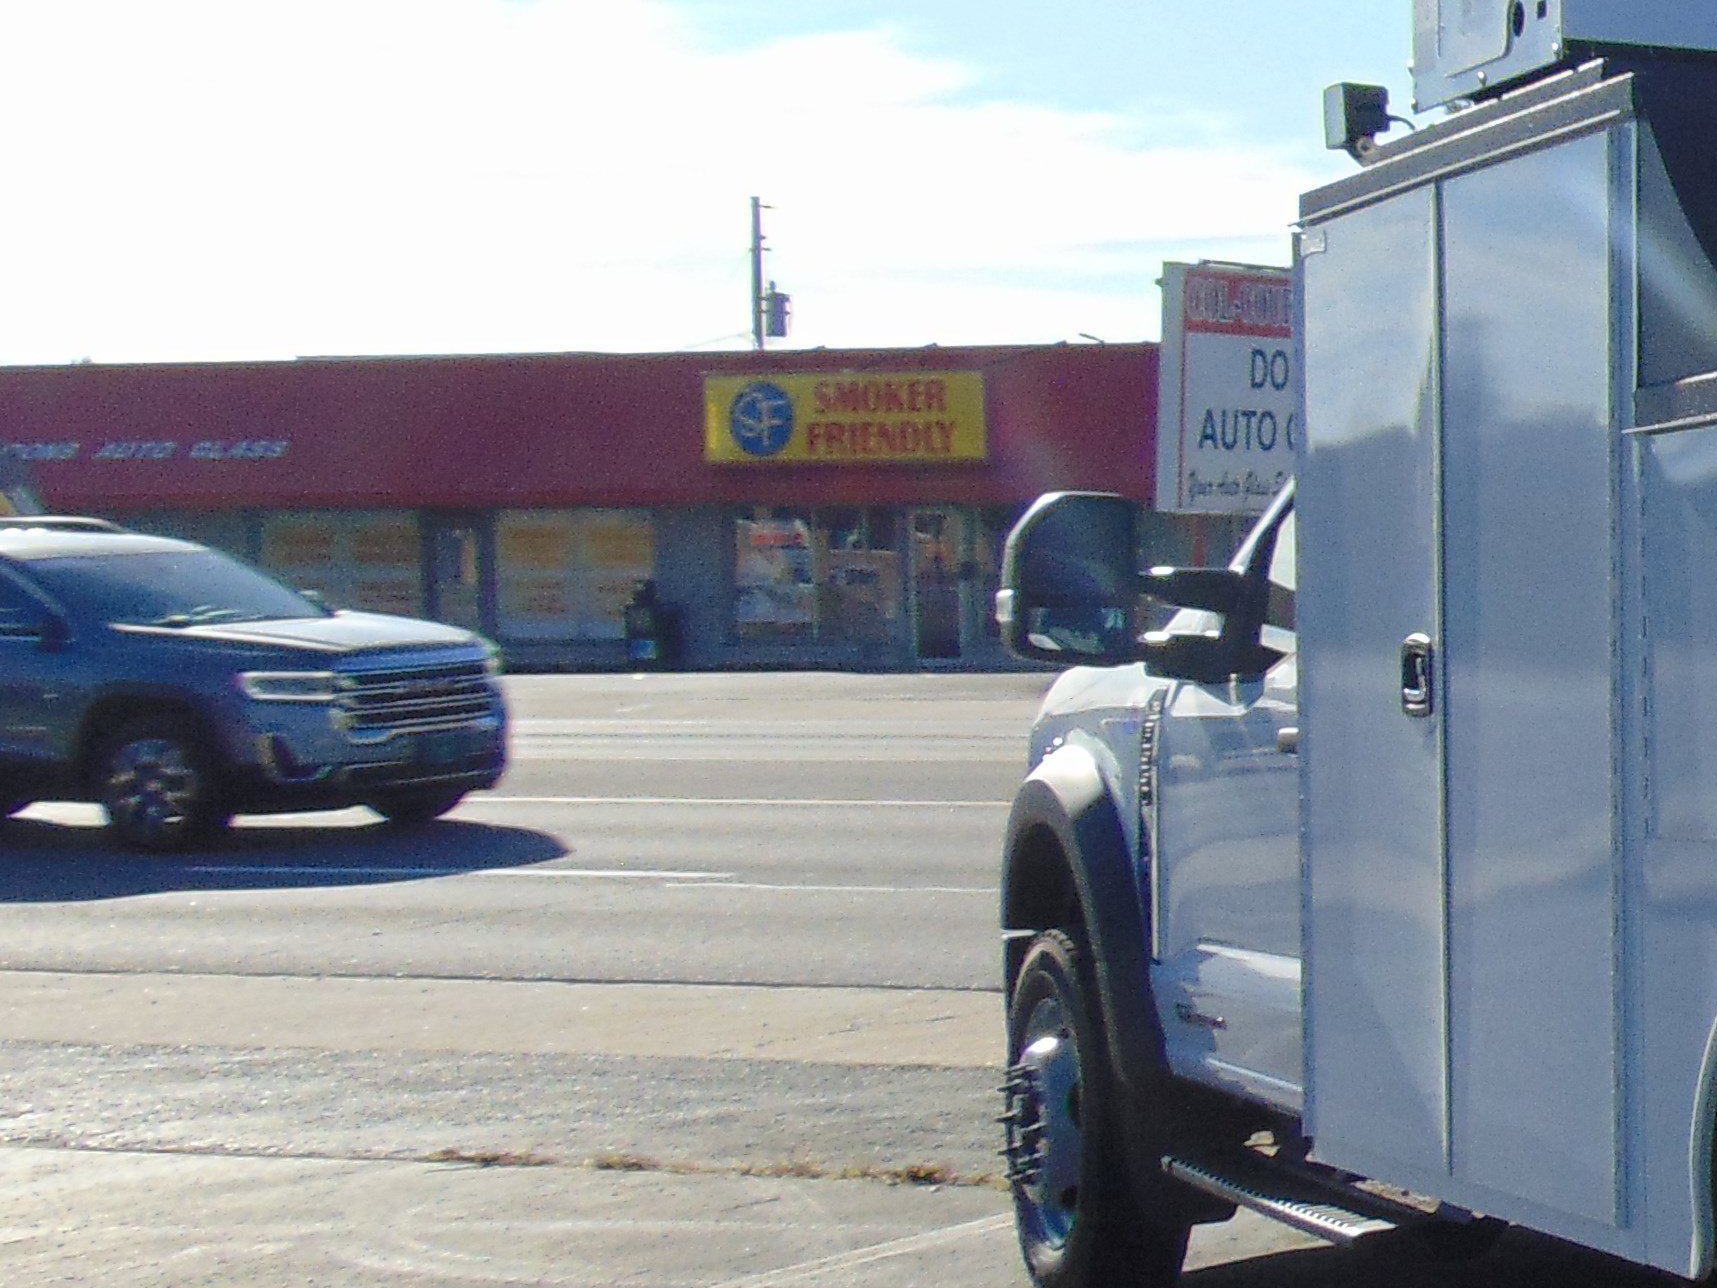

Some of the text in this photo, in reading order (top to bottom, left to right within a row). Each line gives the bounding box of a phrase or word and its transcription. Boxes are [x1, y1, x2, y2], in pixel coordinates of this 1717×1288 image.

[813, 379, 948, 413] SMOKER
[806, 419, 956, 455] FRIENDLY
[1198, 408, 1277, 452] AUTO
[190, 441, 290, 459] GLASS
